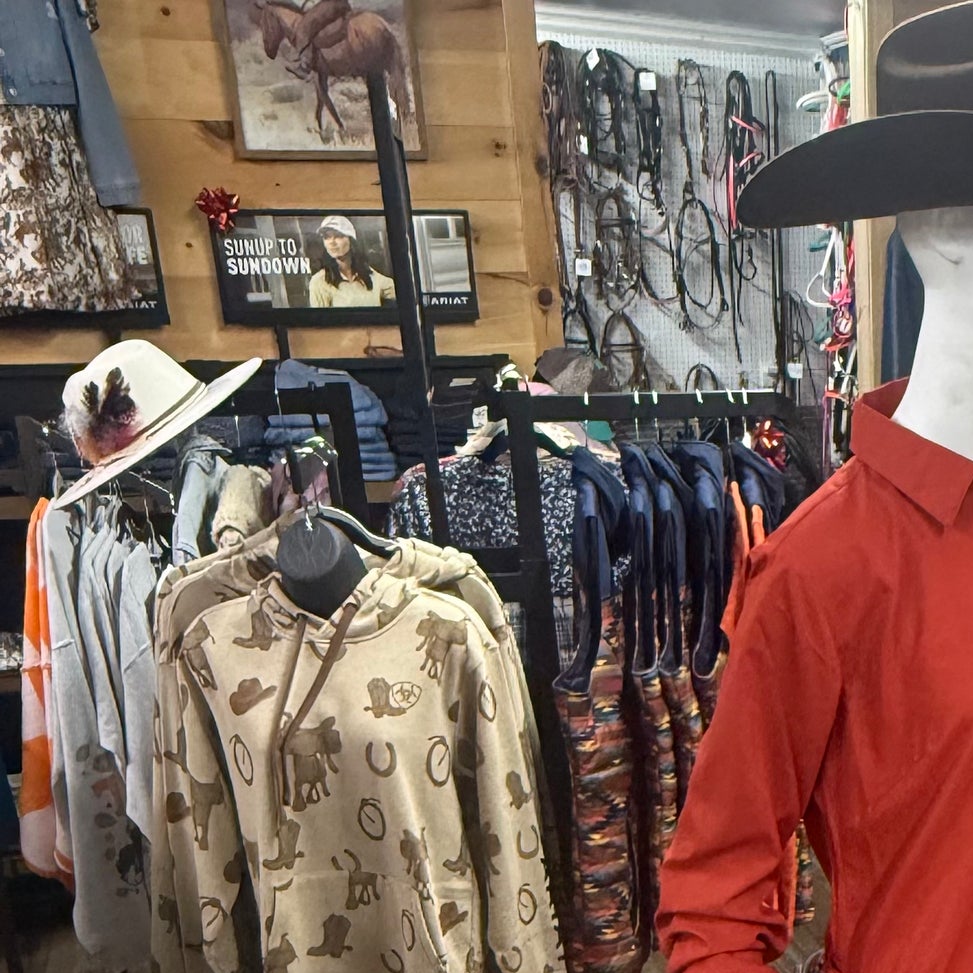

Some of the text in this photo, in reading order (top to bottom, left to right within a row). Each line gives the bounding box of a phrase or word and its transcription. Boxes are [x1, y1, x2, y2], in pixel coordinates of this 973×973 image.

[224, 238, 297, 256] SUNUP TO
[226, 257, 311, 275] SUNDOWN
[431, 296, 469, 305] ARIAT
